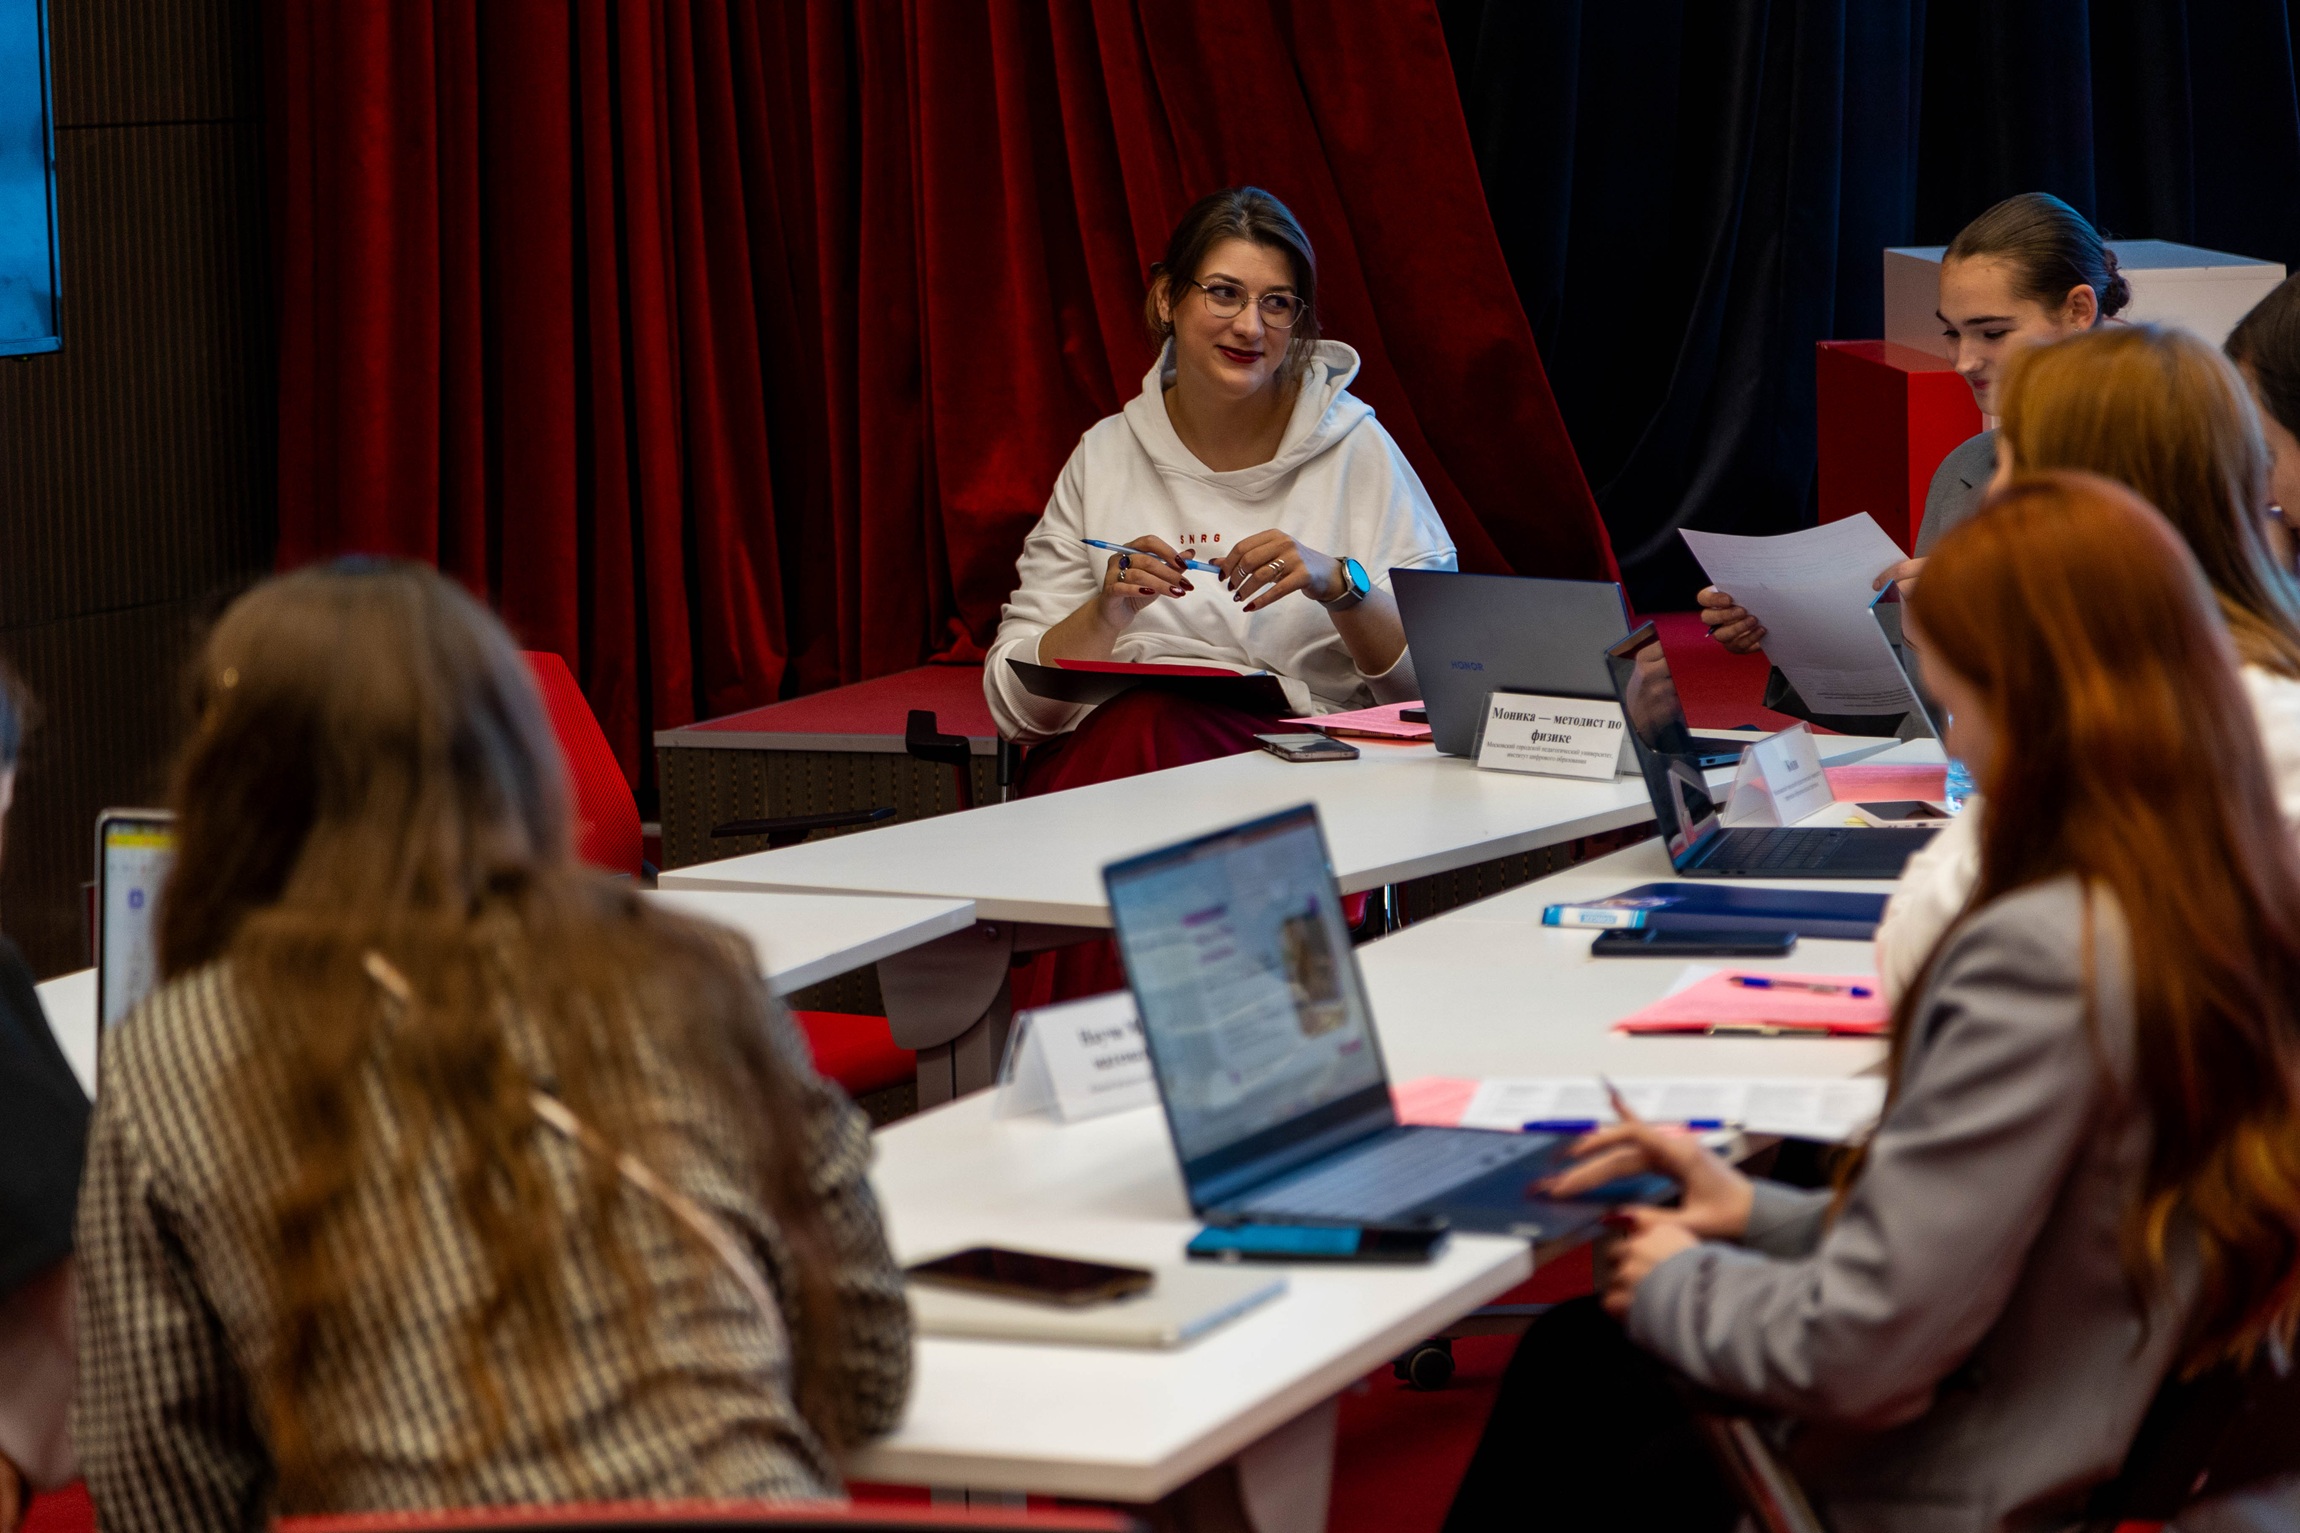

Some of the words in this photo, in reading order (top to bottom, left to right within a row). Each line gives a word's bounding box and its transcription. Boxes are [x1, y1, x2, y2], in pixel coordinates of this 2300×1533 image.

[1180, 533, 1221, 544] SNRG
[1451, 661, 1484, 671] HONOR
[1492, 707, 1536, 722] Моника
[1553, 715, 1605, 728] методист
[1607, 720, 1622, 730] по
[1531, 729, 1572, 744] физике
